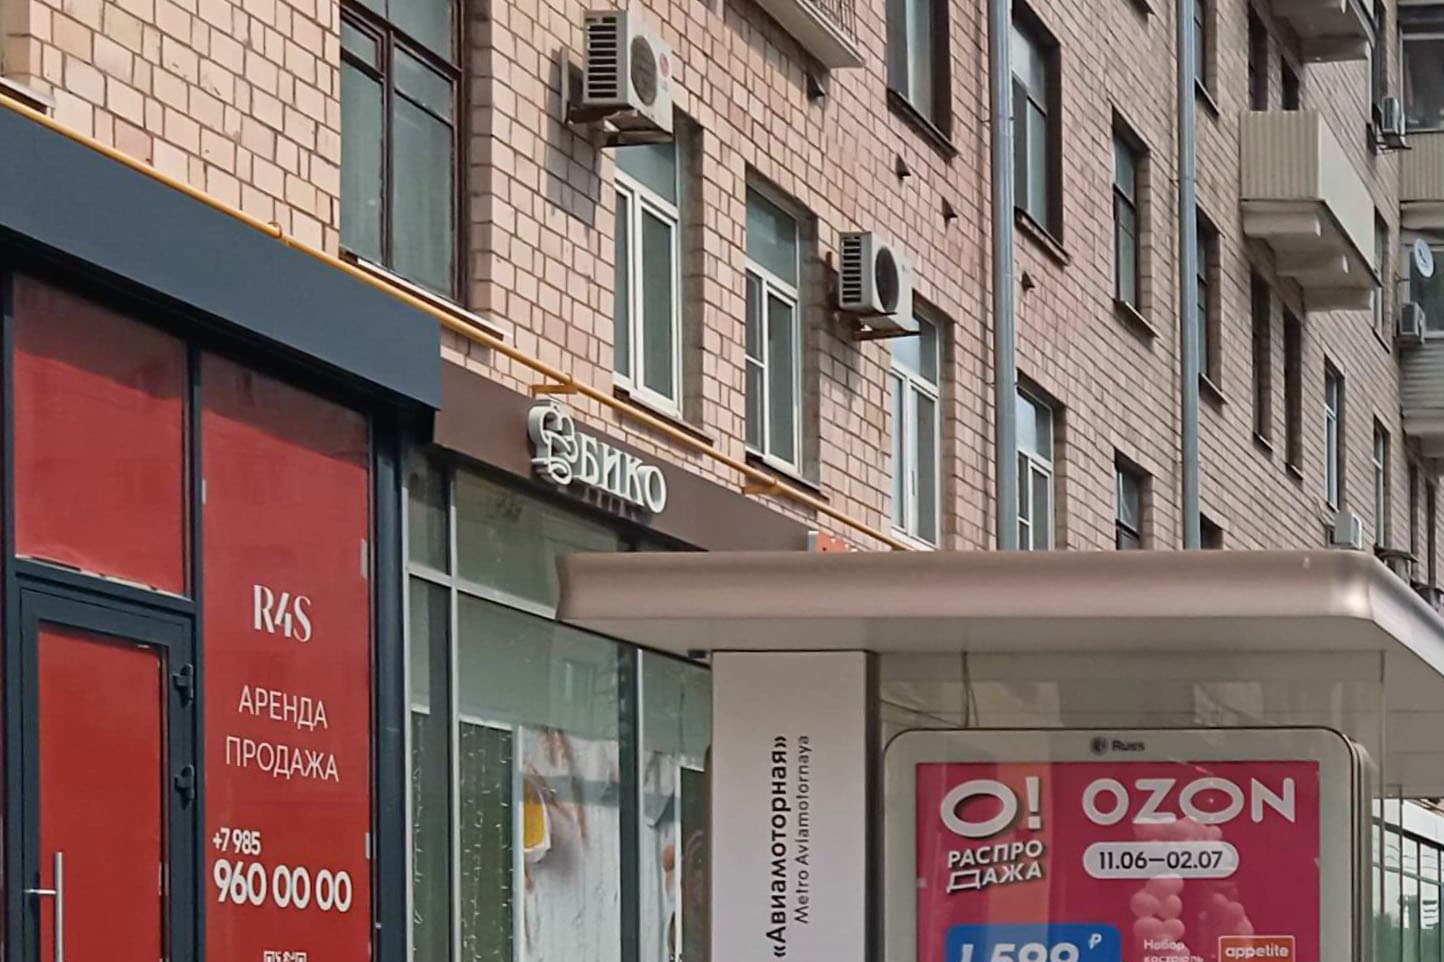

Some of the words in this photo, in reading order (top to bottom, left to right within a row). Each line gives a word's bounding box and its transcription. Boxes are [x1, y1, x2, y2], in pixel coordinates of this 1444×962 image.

[238, 685, 328, 731] АРЕНДА
[226, 736, 339, 782] ПРОДАЖА
[794, 735, 813, 866] Aviamotornaya
[1082, 777, 1296, 825] OZON
[212, 827, 230, 852] +7
[232, 829, 261, 856] 985
[766, 735, 791, 958] «Авиамоторная»
[947, 839, 1043, 868] РАСПРО
[213, 858, 267, 906] 960
[272, 864, 311, 909] 00
[315, 869, 353, 912] 00
[794, 869, 810, 924] Metro
[946, 864, 1043, 892] ДАЖА
[1144, 939, 1185, 953] Набор
[1225, 944, 1289, 959] appetite
